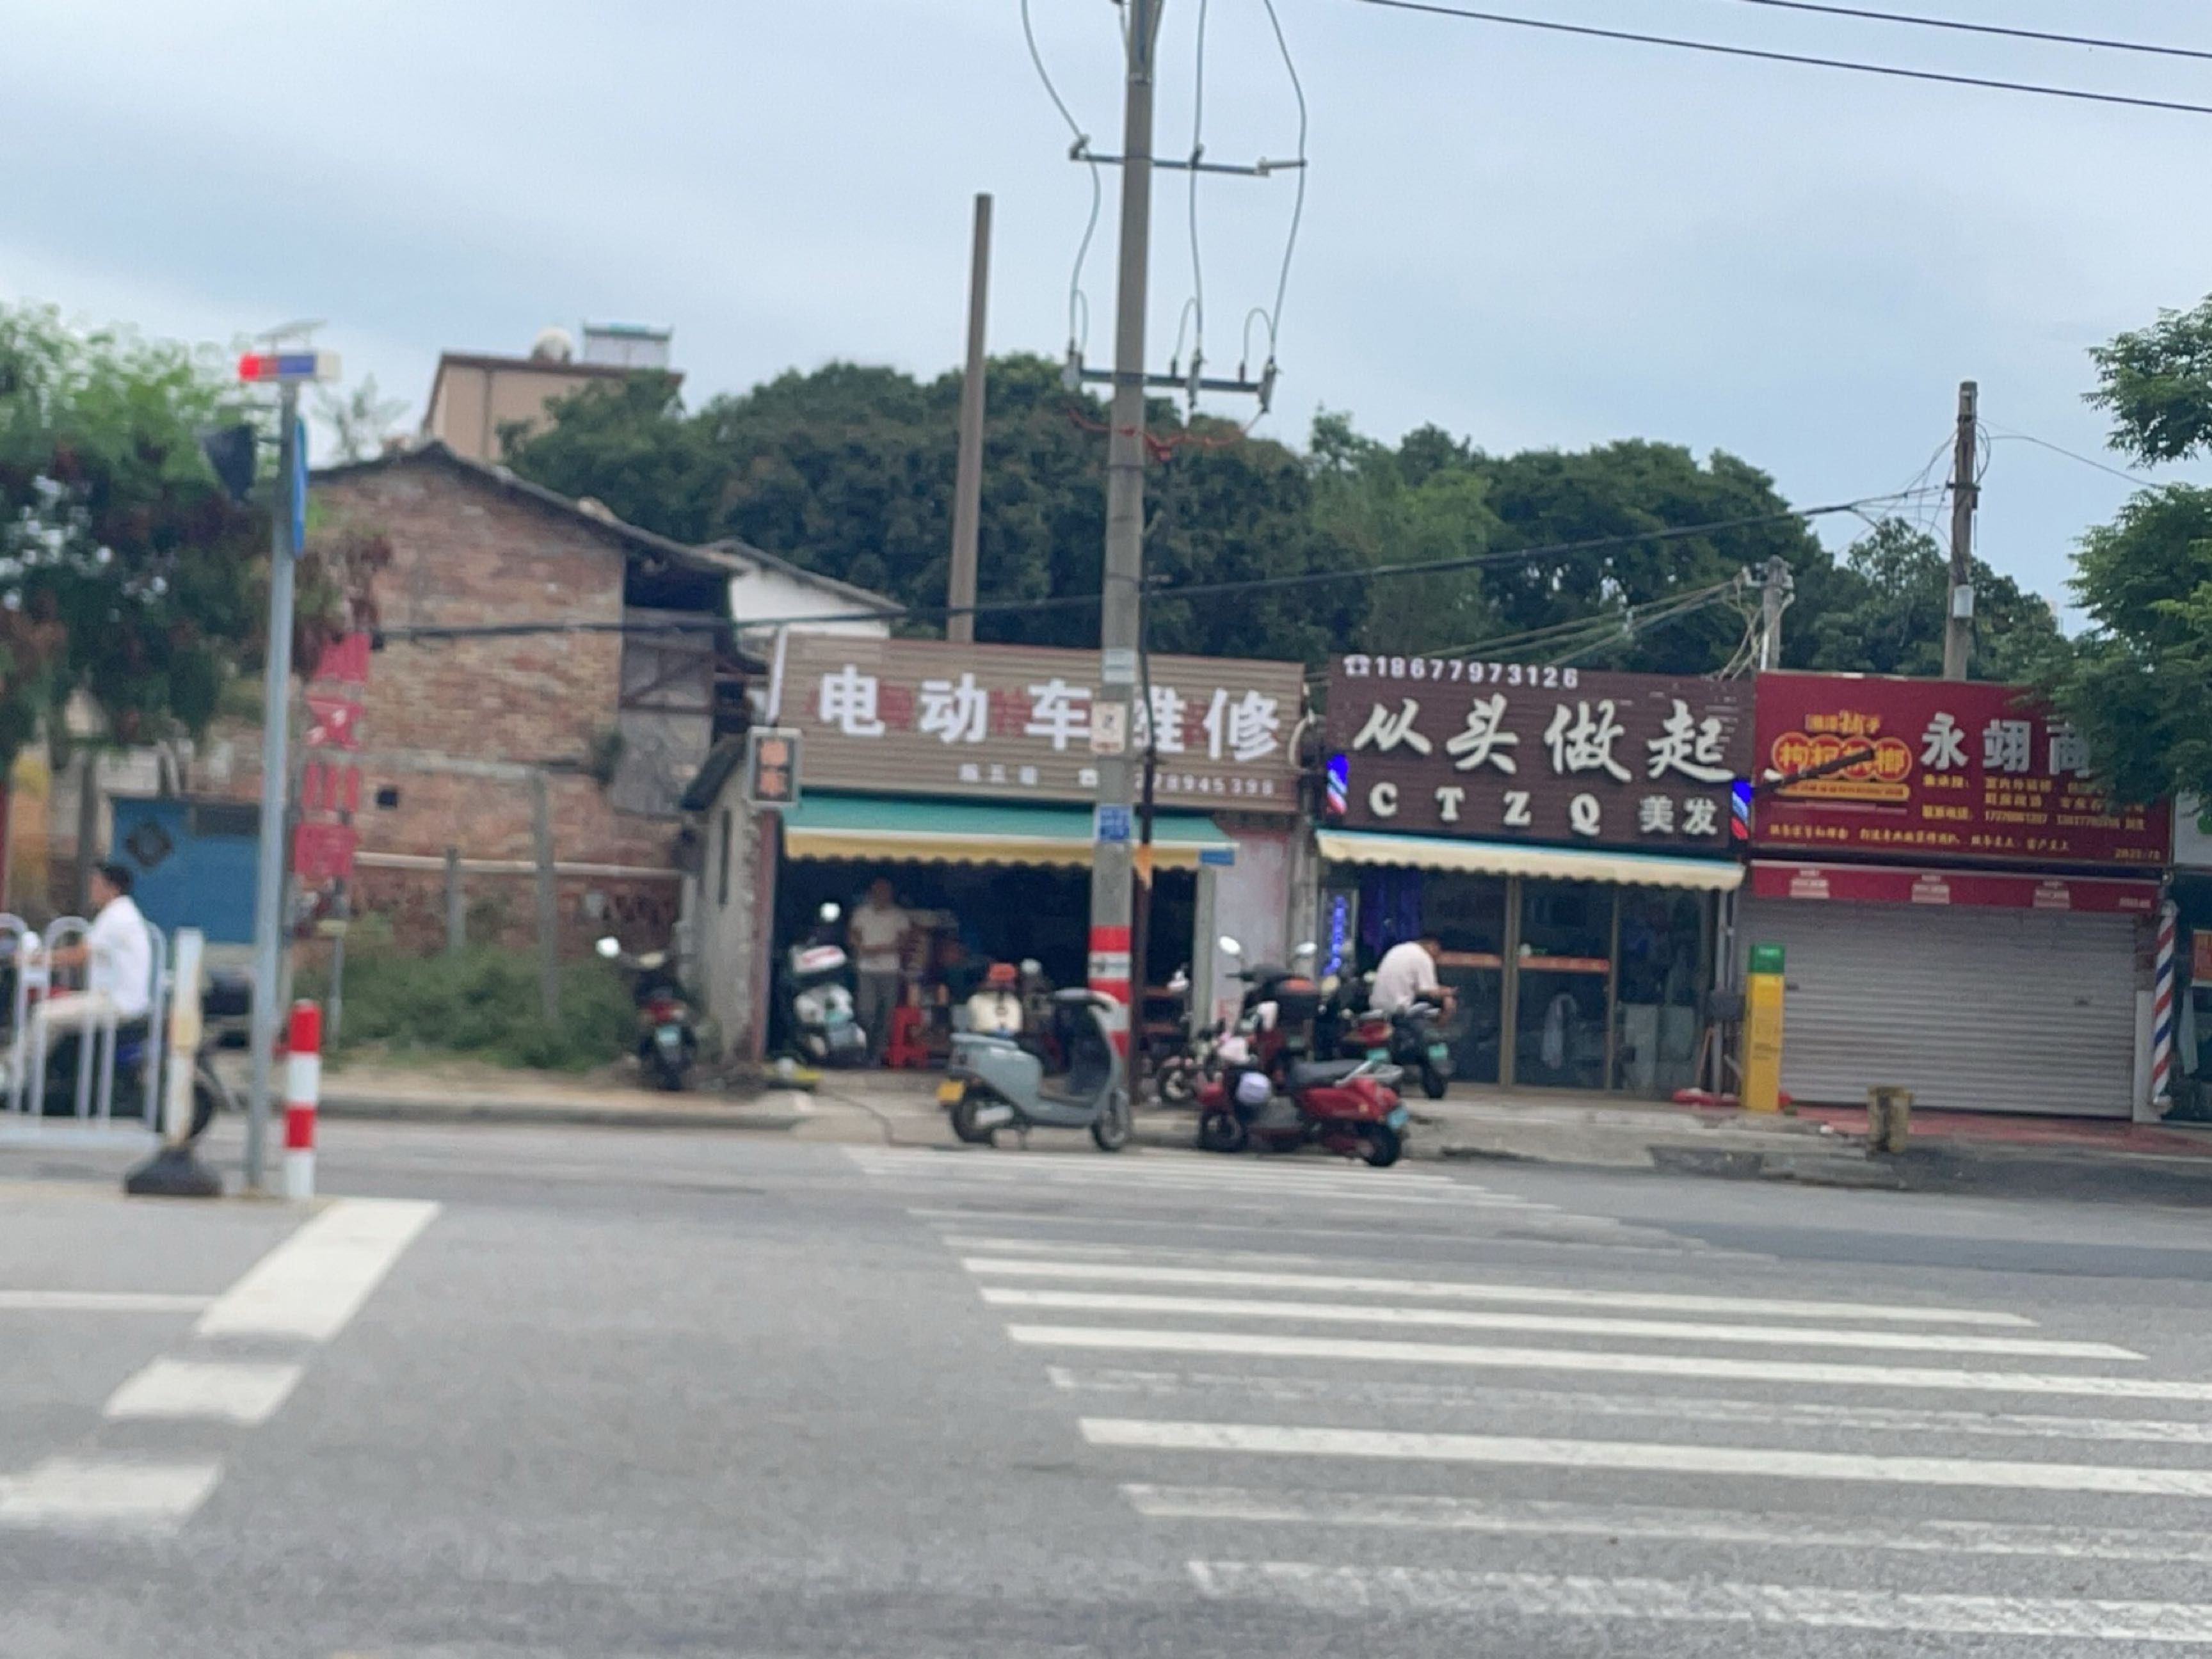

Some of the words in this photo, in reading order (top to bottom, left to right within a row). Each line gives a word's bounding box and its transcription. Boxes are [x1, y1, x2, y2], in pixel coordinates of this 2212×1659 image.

[1376, 655, 1578, 689] 18677973126
[819, 664, 1280, 760] 电动车维修
[1352, 693, 1735, 783] 从头做起
[1639, 796, 1718, 835] 美发
